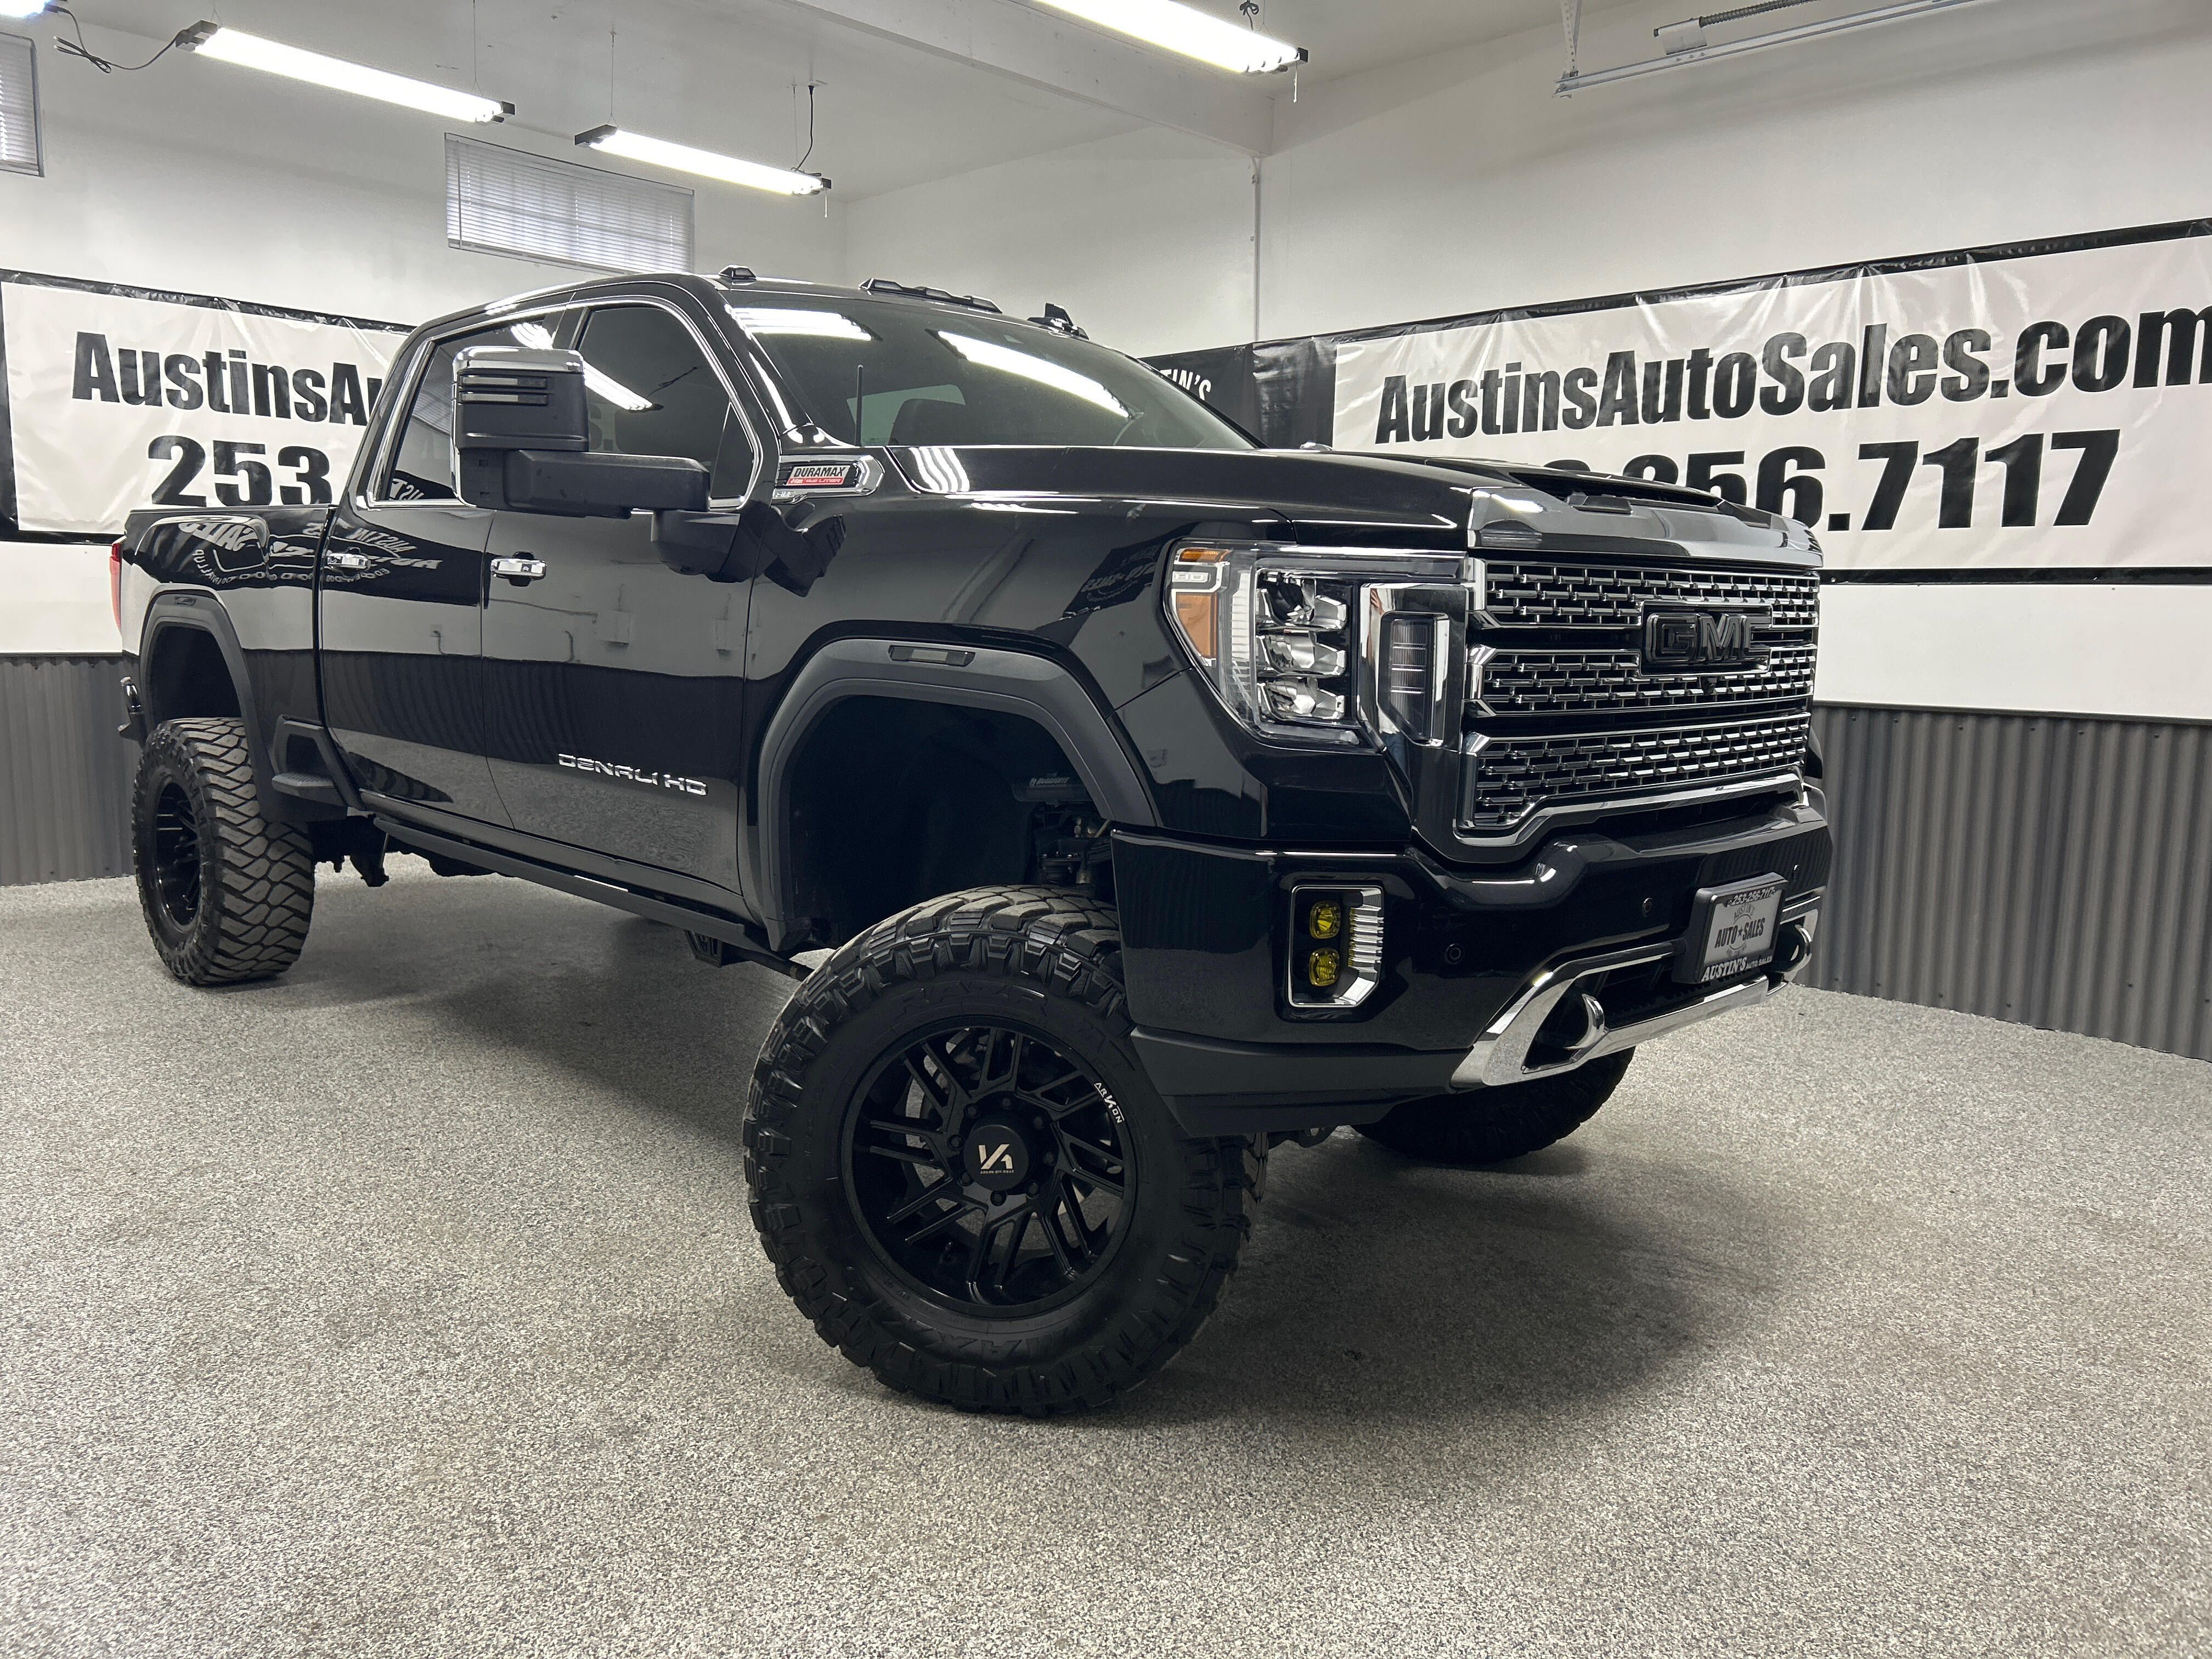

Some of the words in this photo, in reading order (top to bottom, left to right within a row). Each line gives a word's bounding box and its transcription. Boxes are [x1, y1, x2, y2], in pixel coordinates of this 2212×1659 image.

[1375, 305, 2212, 444] AustinsAutoSales.com
[148, 436, 331, 506] 253
[794, 467, 845, 477] DURAMAX
[1175, 573, 1205, 582] HD
[1646, 612, 1771, 663] GMC
[558, 753, 658, 786] DENALI
[663, 774, 708, 796] HD
[1731, 887, 1776, 905] 253-256-7117
[1714, 925, 1738, 949] AUTO
[1742, 917, 1765, 941] SALES
[1701, 956, 1747, 982] AUSTIN'S
[1745, 960, 1758, 970] AUTO
[1758, 955, 1773, 966] SALES
[1093, 1081, 1125, 1124] ARKON
